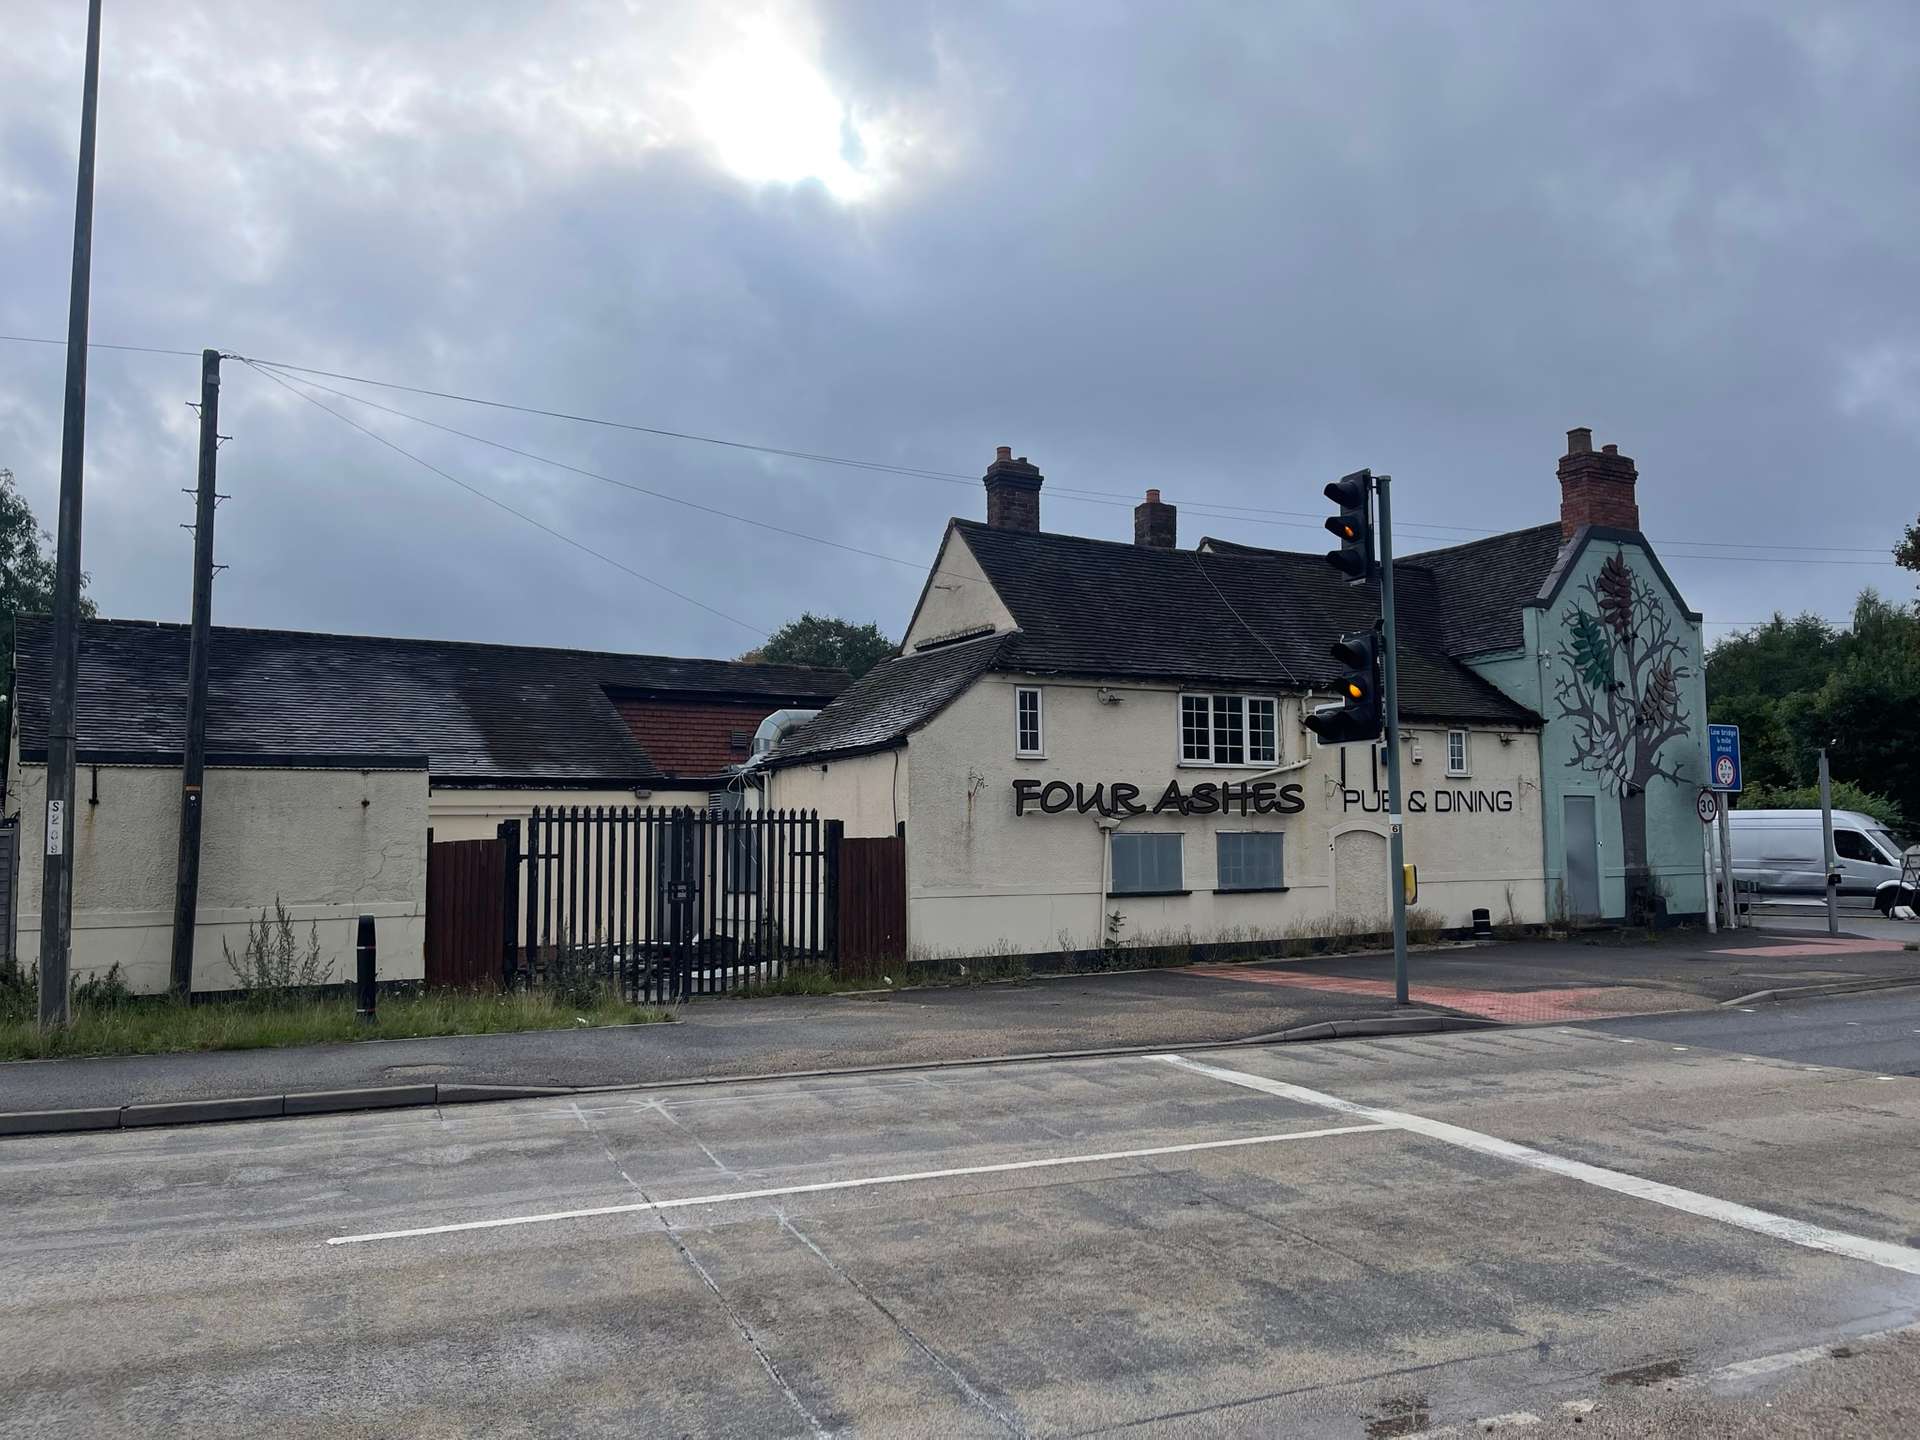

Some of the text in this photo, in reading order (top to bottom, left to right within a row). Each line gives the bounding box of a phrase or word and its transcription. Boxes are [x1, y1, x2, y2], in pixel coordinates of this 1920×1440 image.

[1012, 779, 1306, 817] FOUR ASHES
[1408, 790, 1427, 813] &
[1435, 790, 1513, 813] DINING
[1700, 799, 1714, 813] 30
[1391, 825, 1399, 833] 6
